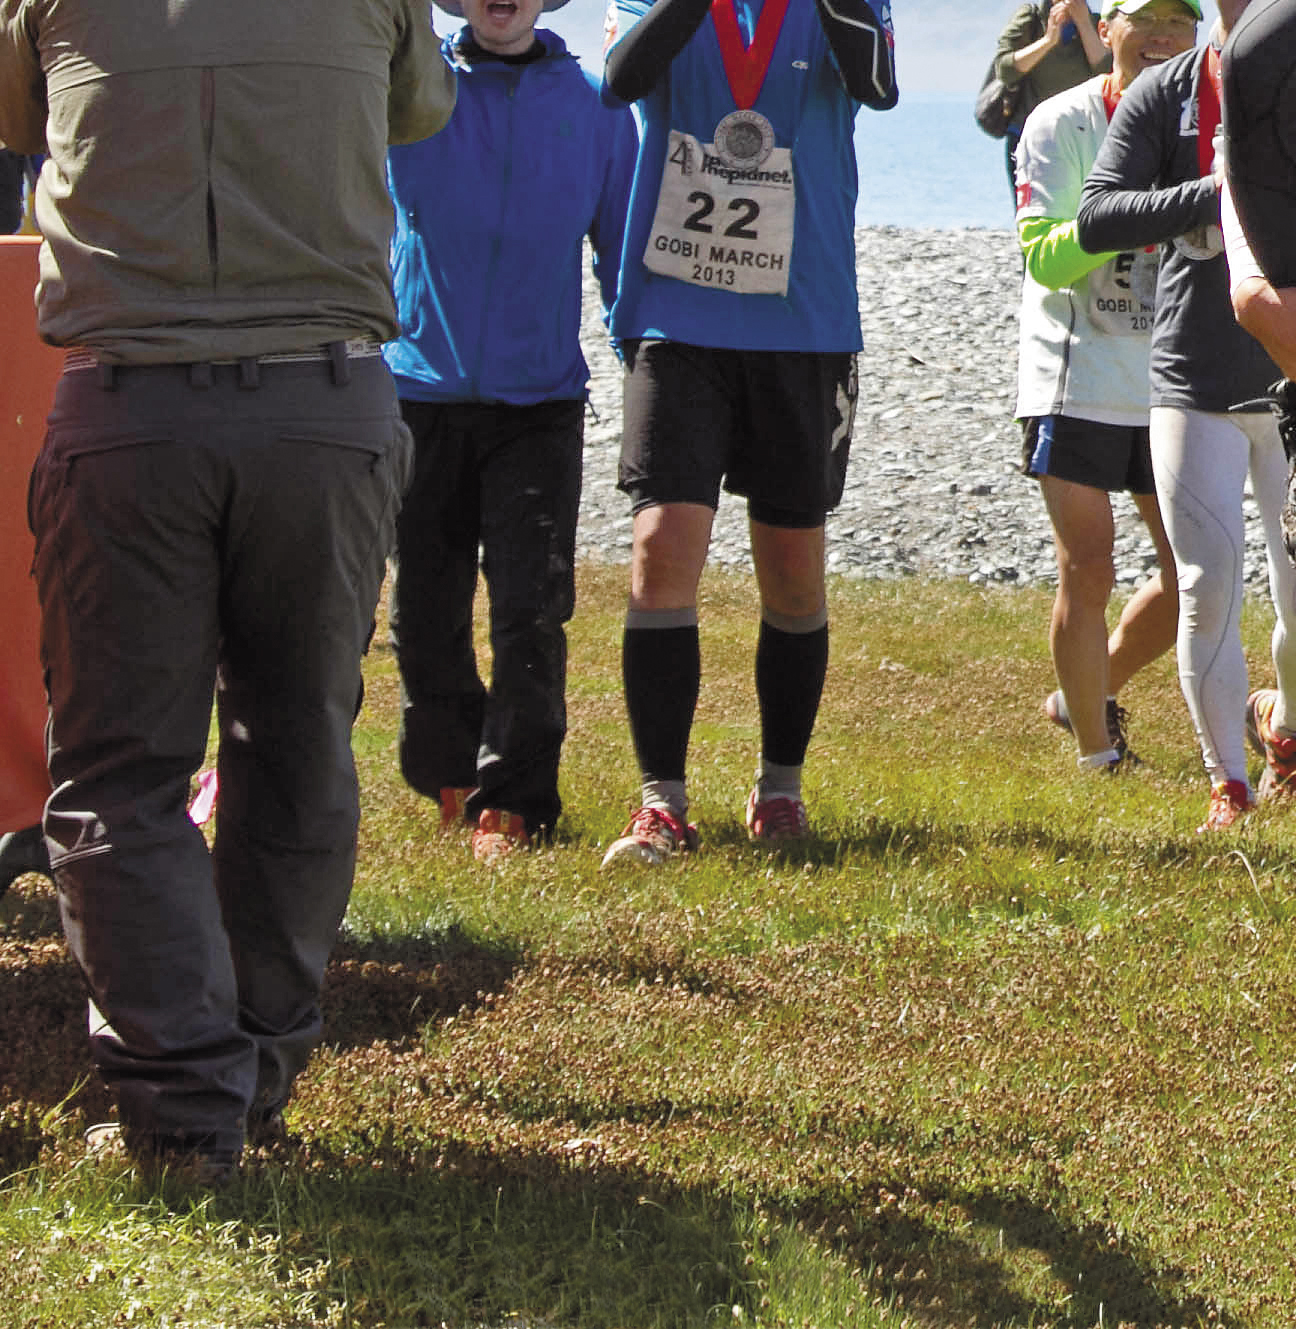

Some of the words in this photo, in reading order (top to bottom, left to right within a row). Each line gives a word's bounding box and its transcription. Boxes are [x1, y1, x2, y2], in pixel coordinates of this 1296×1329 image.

[669, 140, 689, 177] 4
[683, 191, 760, 240] 22
[655, 234, 700, 259] GOBI
[709, 246, 784, 271] MARCH
[692, 264, 736, 286] 2013
[1096, 298, 1132, 313] GOBI
